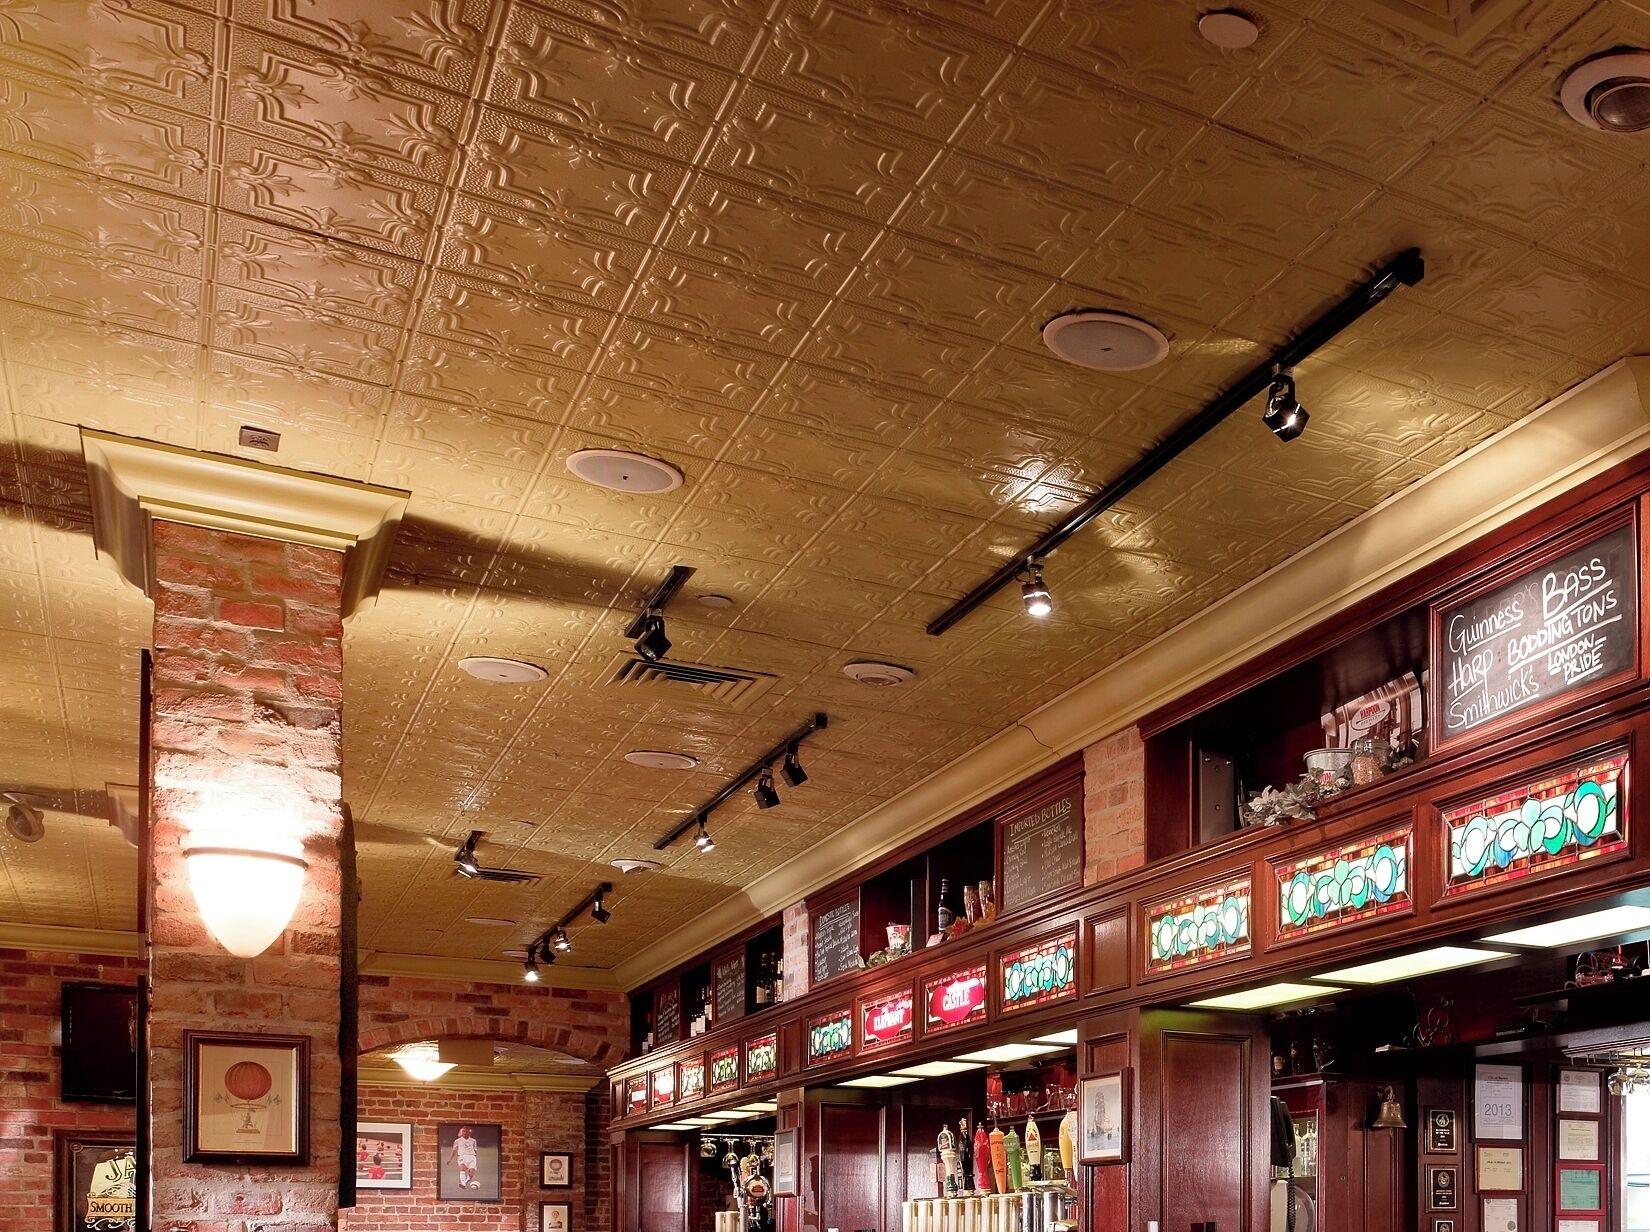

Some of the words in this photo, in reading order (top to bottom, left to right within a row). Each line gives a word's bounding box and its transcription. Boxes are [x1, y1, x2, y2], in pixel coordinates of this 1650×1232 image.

[1542, 558, 1606, 620] BASS
[1448, 600, 1524, 656] Guinness
[1507, 590, 1618, 667] BODDINGTONS
[1562, 643, 1604, 682] PRIDE
[1448, 664, 1540, 729] Smithwick's
[1009, 814, 1040, 837] IMPORTED
[1042, 798, 1072, 822] BOTTLES
[1484, 1103, 1512, 1117] 2013
[90, 1201, 133, 1213] SMOOTH
